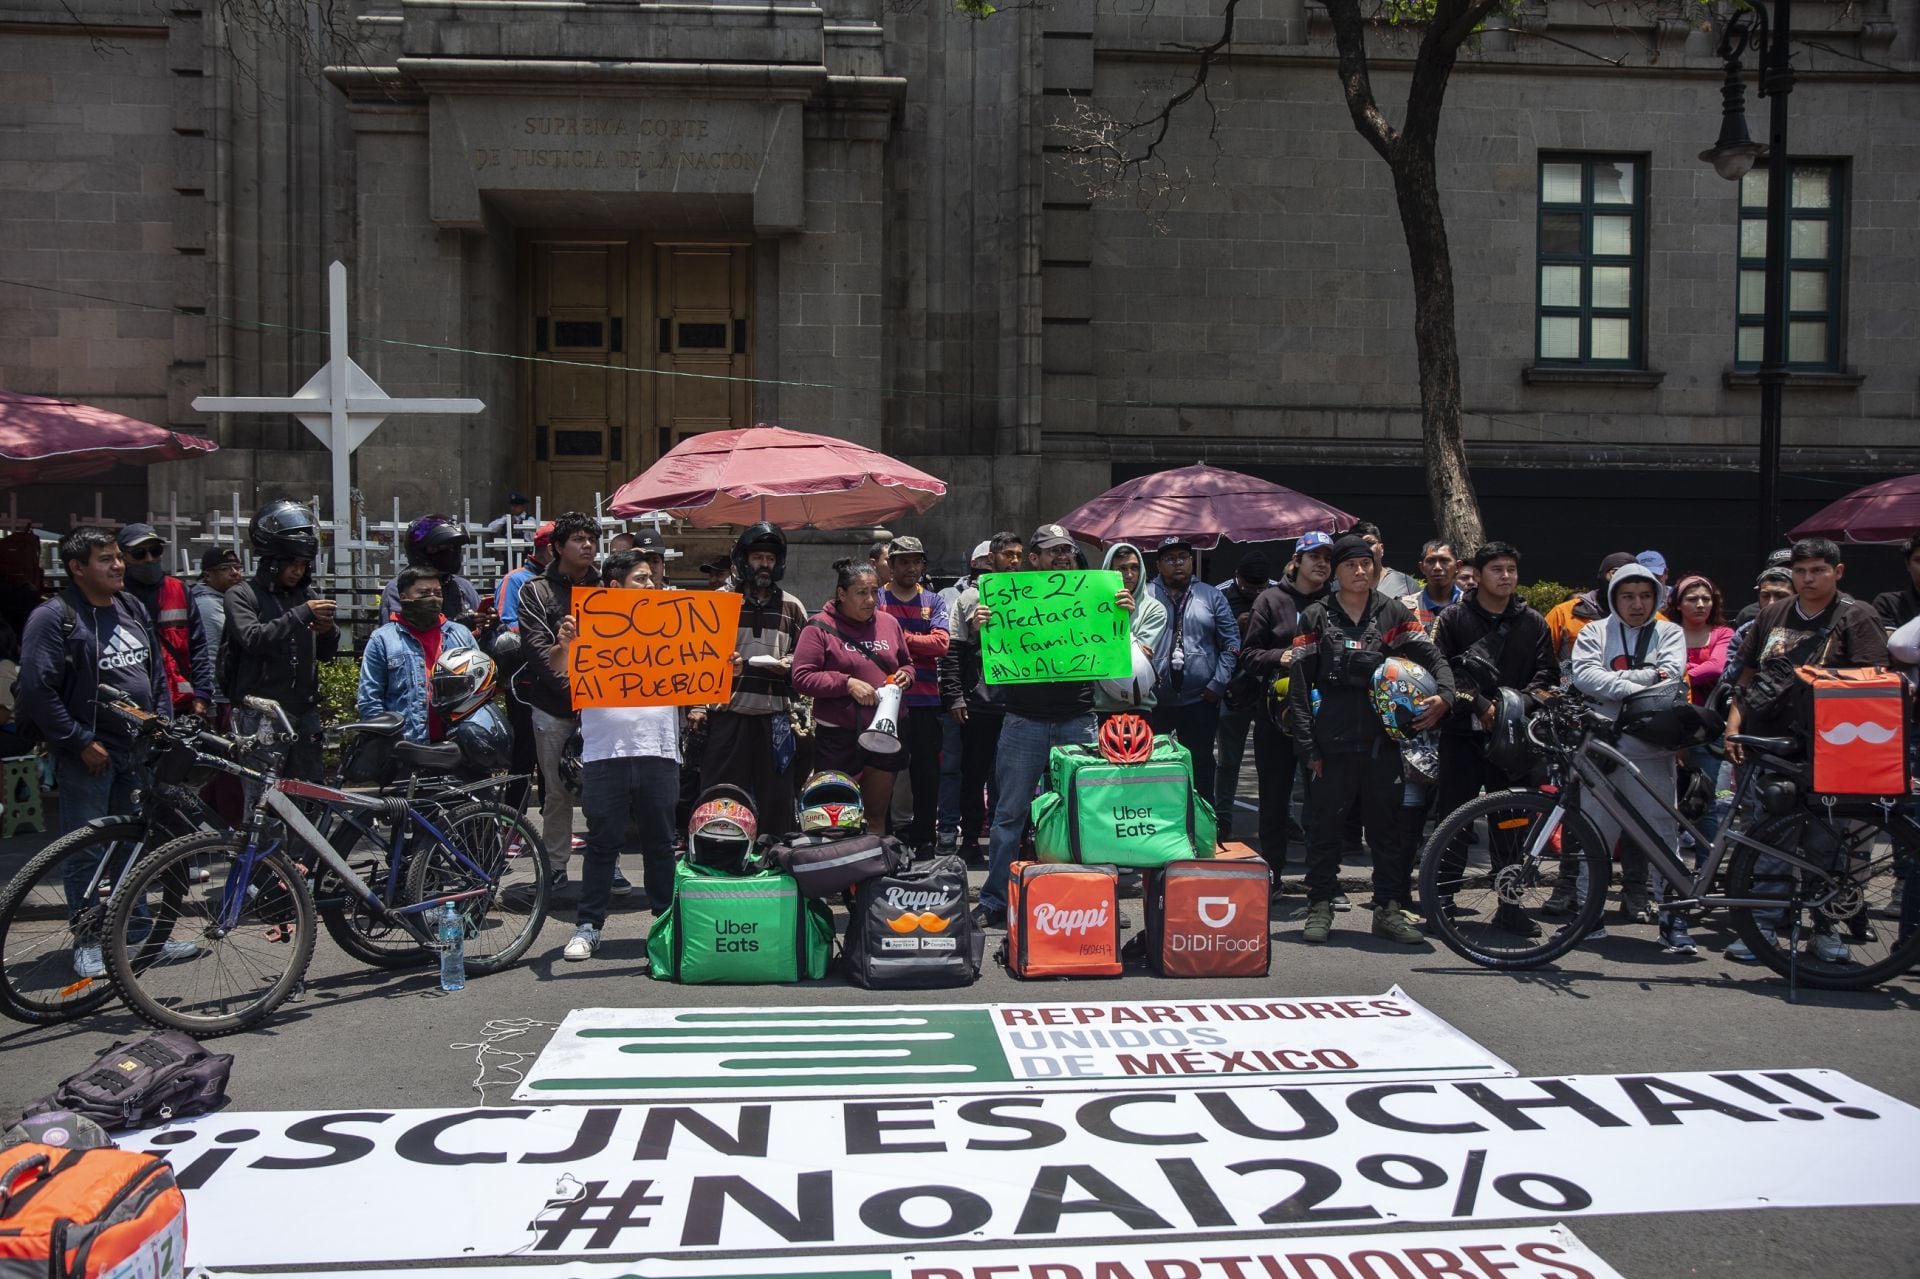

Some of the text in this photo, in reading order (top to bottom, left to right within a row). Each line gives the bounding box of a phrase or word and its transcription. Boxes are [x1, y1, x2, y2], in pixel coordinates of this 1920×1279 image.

[524, 117, 709, 138] SUPREMA CORTE
[476, 148, 502, 171] DE
[509, 149, 608, 171] JUSTICIA
[617, 150, 642, 170] DE
[982, 578, 1039, 608] Este
[985, 601, 1114, 633] Afectará a
[575, 640, 720, 673] ESCUCHA
[844, 639, 890, 652] GESS
[987, 639, 1013, 656] Mi
[98, 649, 149, 670] adidas
[1113, 805, 1153, 821] Uber
[1115, 822, 1157, 838] Eats
[885, 885, 950, 911] Rappi
[715, 919, 759, 935] Uber
[1033, 900, 1109, 936] Rappi
[715, 937, 760, 953] Eats
[1172, 934, 1261, 952] DiDi Food
[1000, 999, 1413, 1027] REPARTIDORES
[1009, 1026, 1228, 1051] UNIDOS
[1019, 1047, 1360, 1079] DE MÉXICO
[843, 1072, 1881, 1156] ESCUCHA!!
